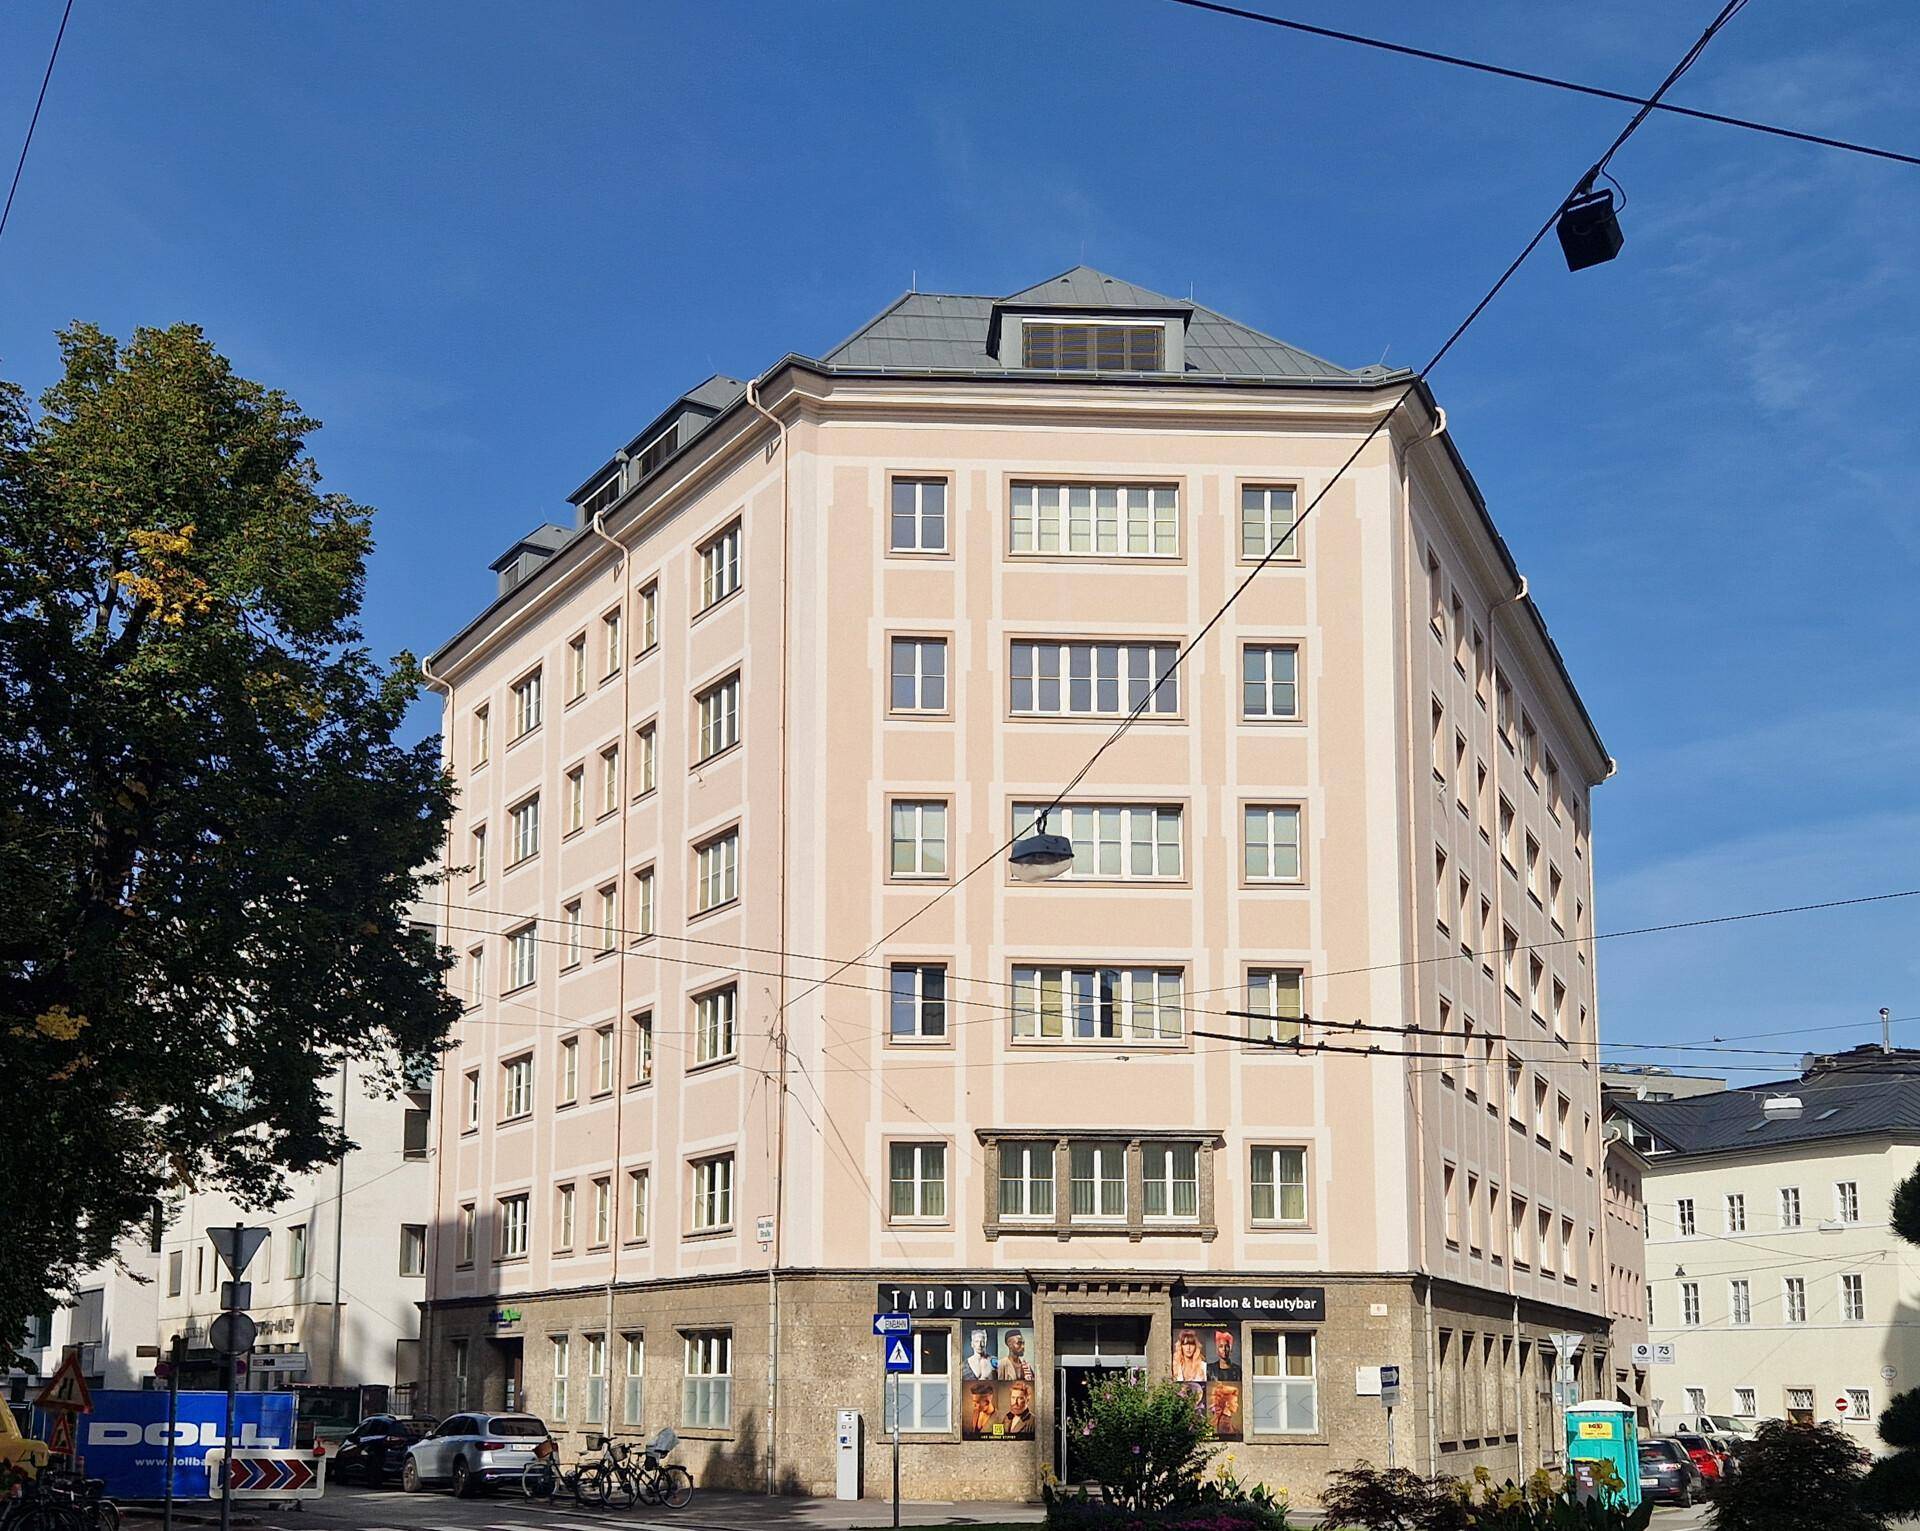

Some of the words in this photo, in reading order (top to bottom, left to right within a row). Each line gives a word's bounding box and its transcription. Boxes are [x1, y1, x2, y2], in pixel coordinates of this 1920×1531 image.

[891, 1290, 1020, 1310] TARQUINI
[1181, 1295, 1239, 1309] hairsalon
[1242, 1297, 1251, 1309] &
[1254, 1296, 1317, 1312] beautybar
[885, 1318, 907, 1329] EINBAHN
[88, 1422, 280, 1446] DOLL
